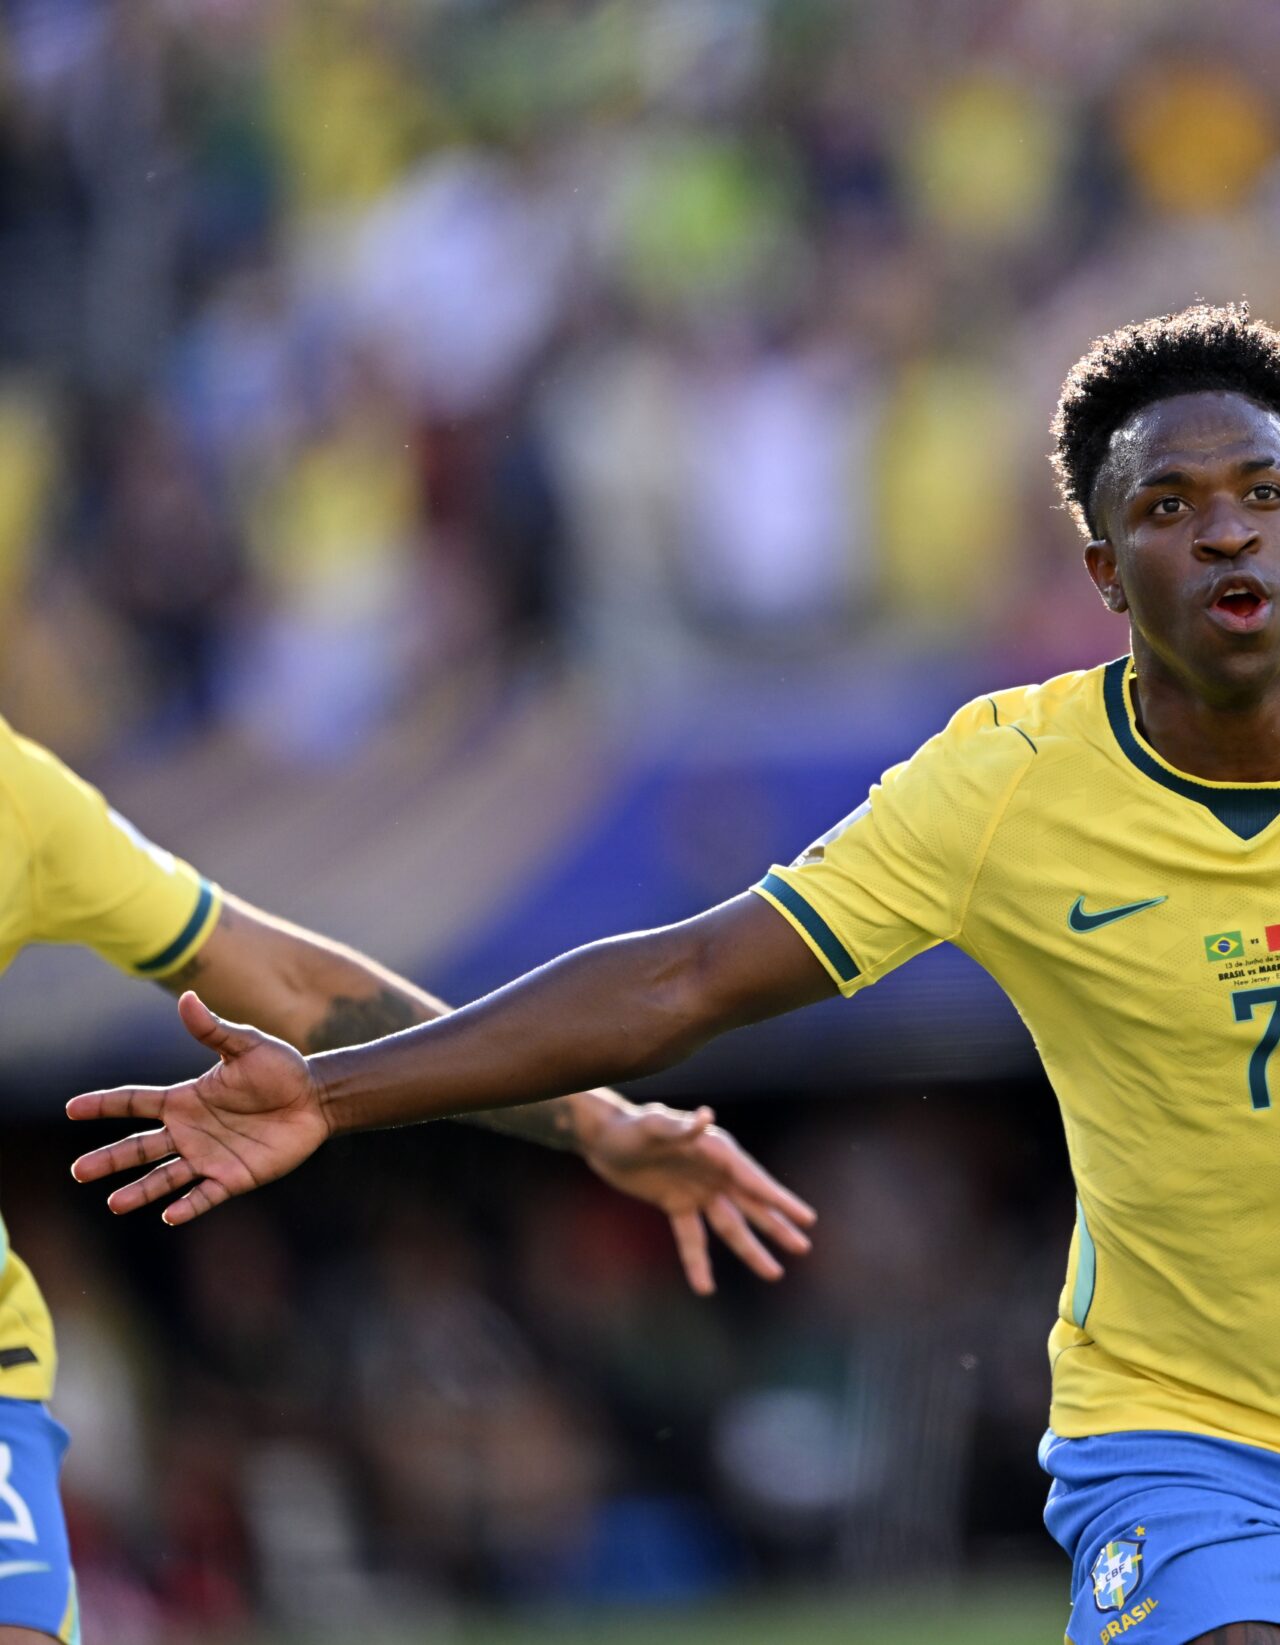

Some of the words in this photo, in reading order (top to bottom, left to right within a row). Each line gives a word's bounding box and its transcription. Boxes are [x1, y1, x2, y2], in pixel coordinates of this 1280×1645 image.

[1218, 970, 1245, 981] BRASIL
[1105, 1563, 1126, 1583] CBF
[1100, 1597, 1159, 1645] BRASIL
